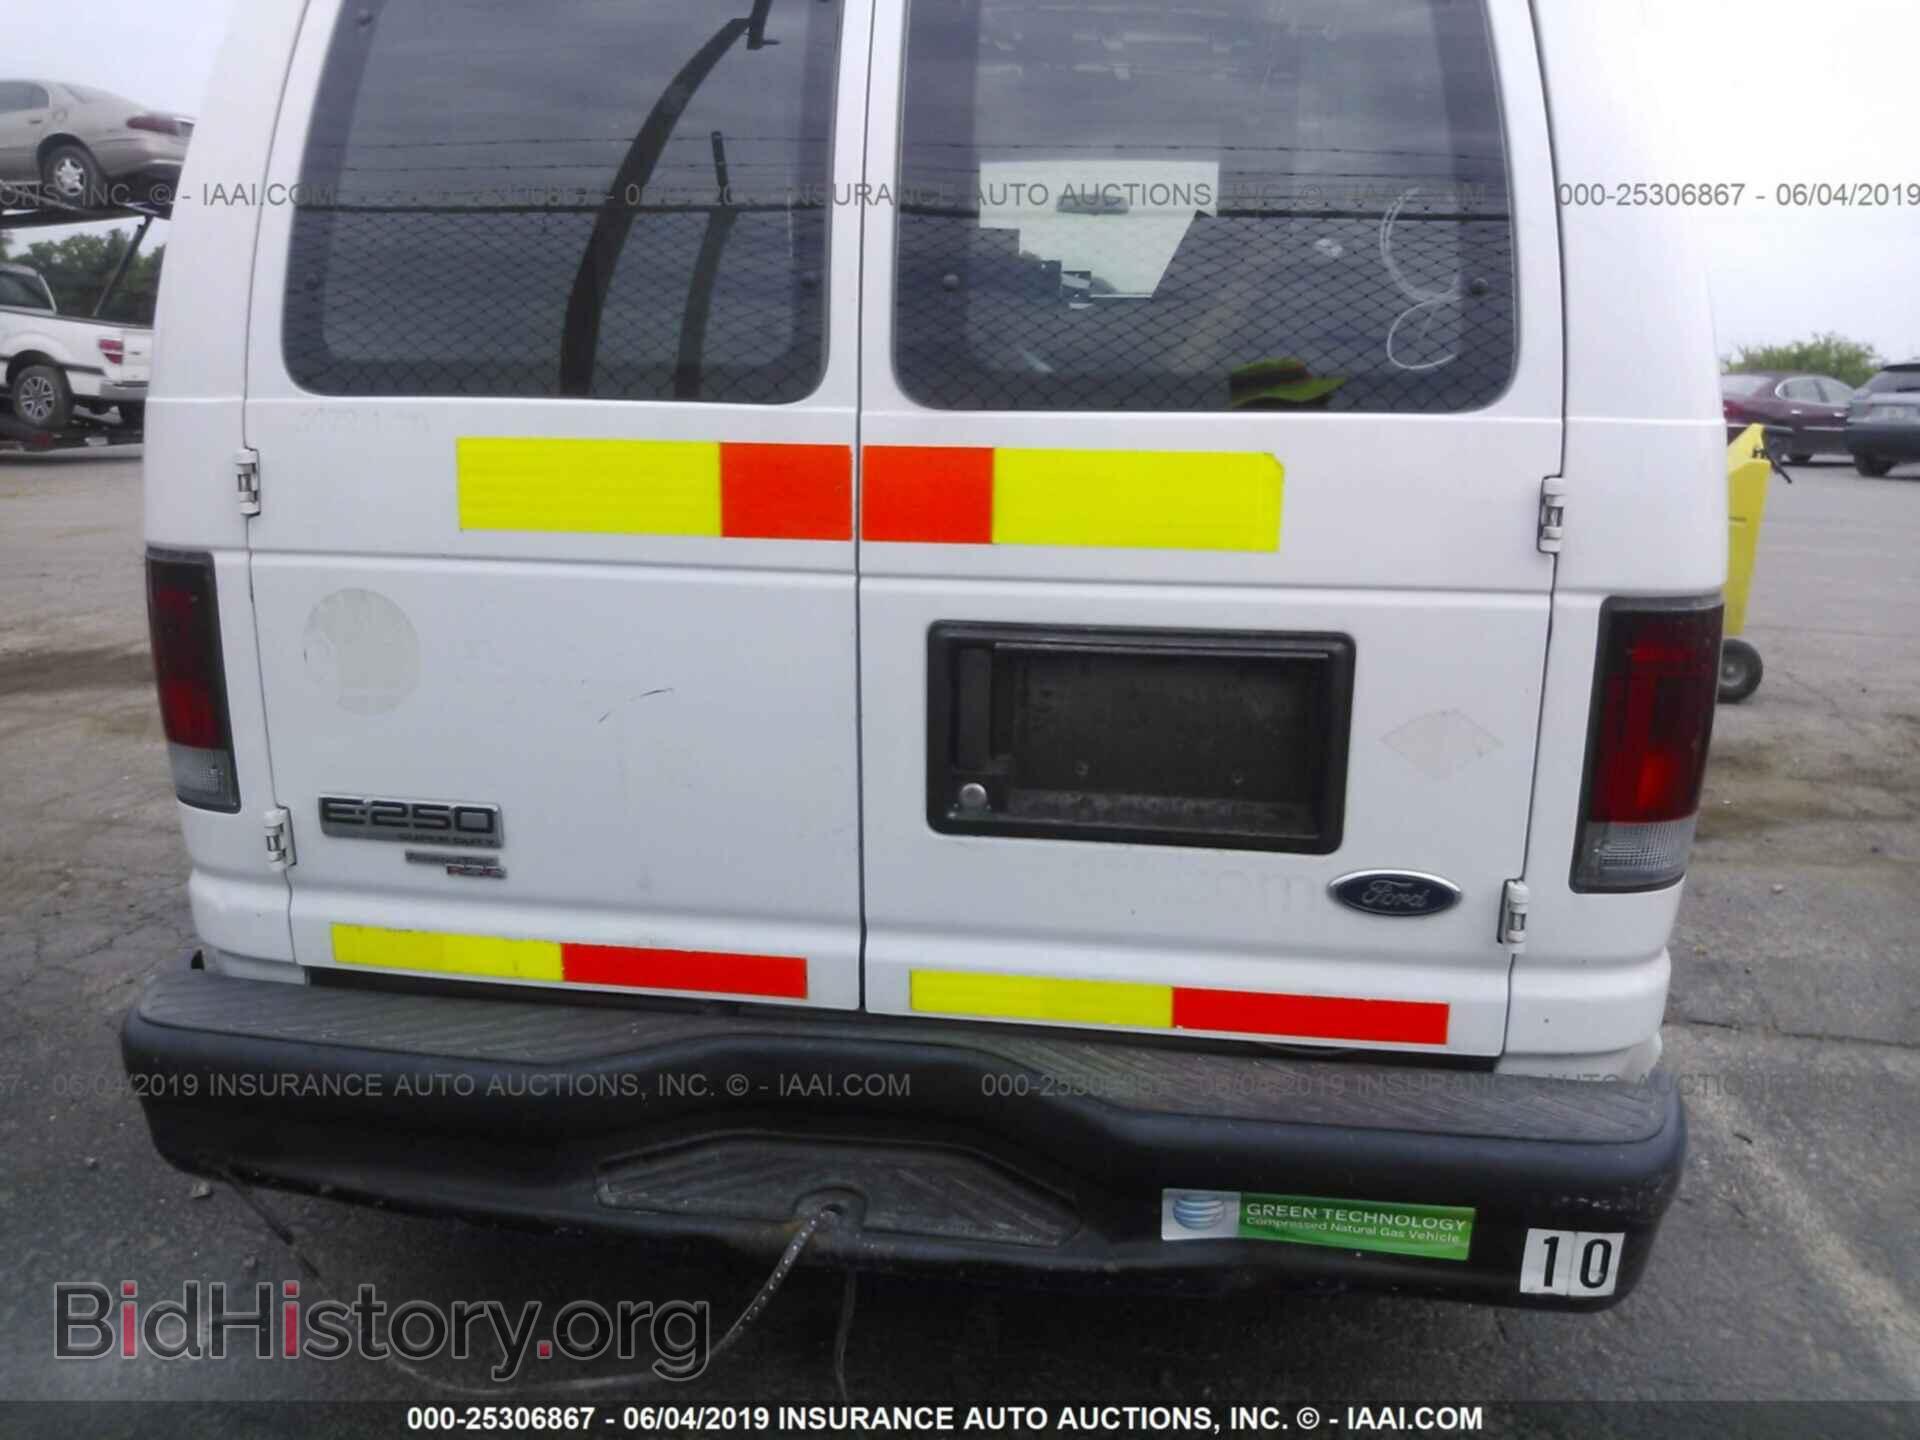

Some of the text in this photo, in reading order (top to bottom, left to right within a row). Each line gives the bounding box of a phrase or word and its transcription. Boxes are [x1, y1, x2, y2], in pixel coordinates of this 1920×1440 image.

[1362, 879, 1431, 907] Ford
[1246, 1202, 1467, 1231] GREEN TECHNOLOGY
[1246, 1216, 1461, 1243] Compressed Natural Gas Vehicle
[1543, 1236, 1612, 1289] 10
